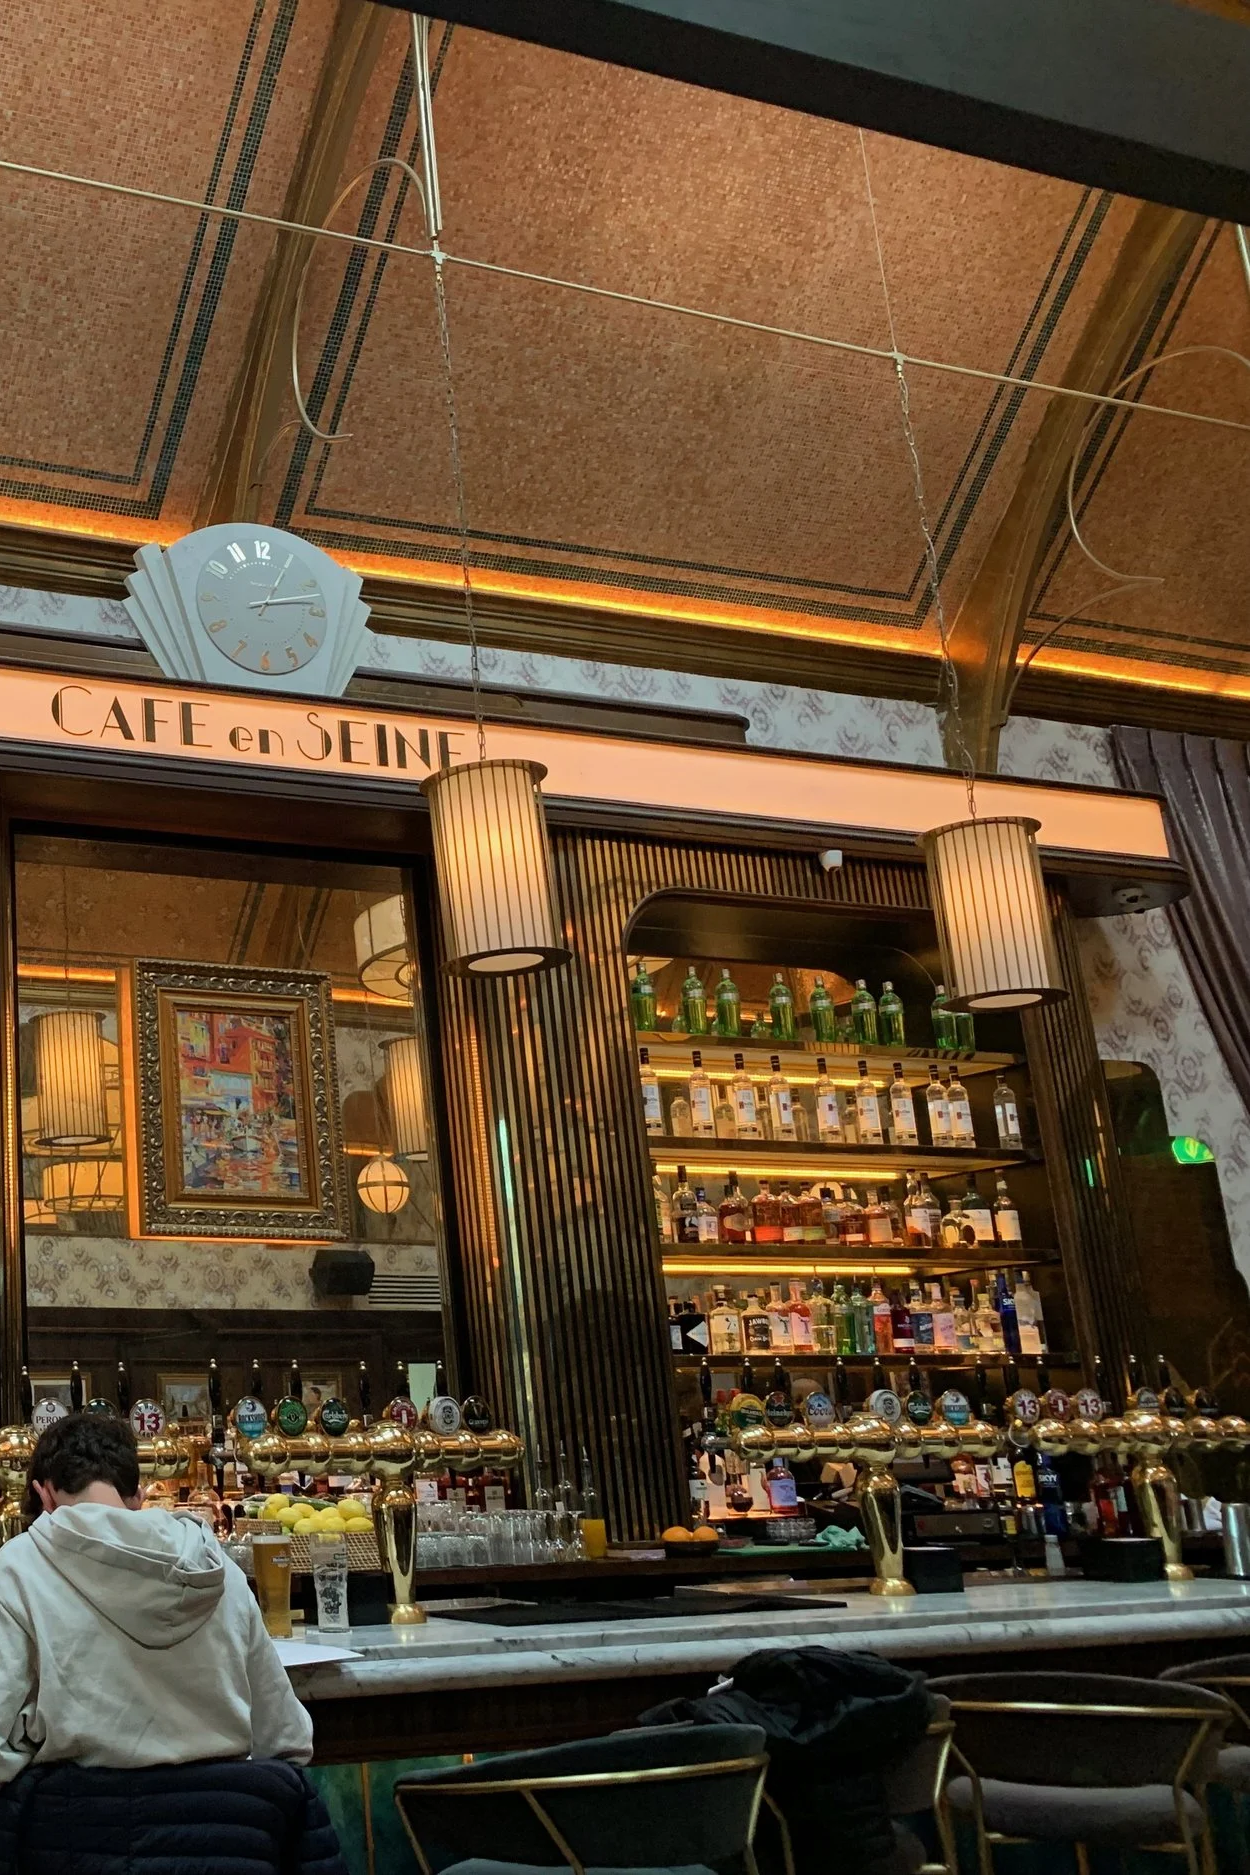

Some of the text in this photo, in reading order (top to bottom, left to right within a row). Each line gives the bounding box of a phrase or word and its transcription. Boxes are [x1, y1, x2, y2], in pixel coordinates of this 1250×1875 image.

[226, 542, 247, 563] 11
[254, 540, 271, 560] 12
[206, 559, 229, 580] 10
[232, 639, 248, 658] 7
[303, 632, 319, 648] 4
[260, 650, 271, 672] 6
[285, 645, 299, 668] 5
[51, 685, 211, 749] CAFE
[229, 724, 285, 757] en
[1017, 1400, 1037, 1415] 13
[1080, 1399, 1099, 1414] 13
[35, 1416, 64, 1424] PERON
[135, 1413, 160, 1431] 13
